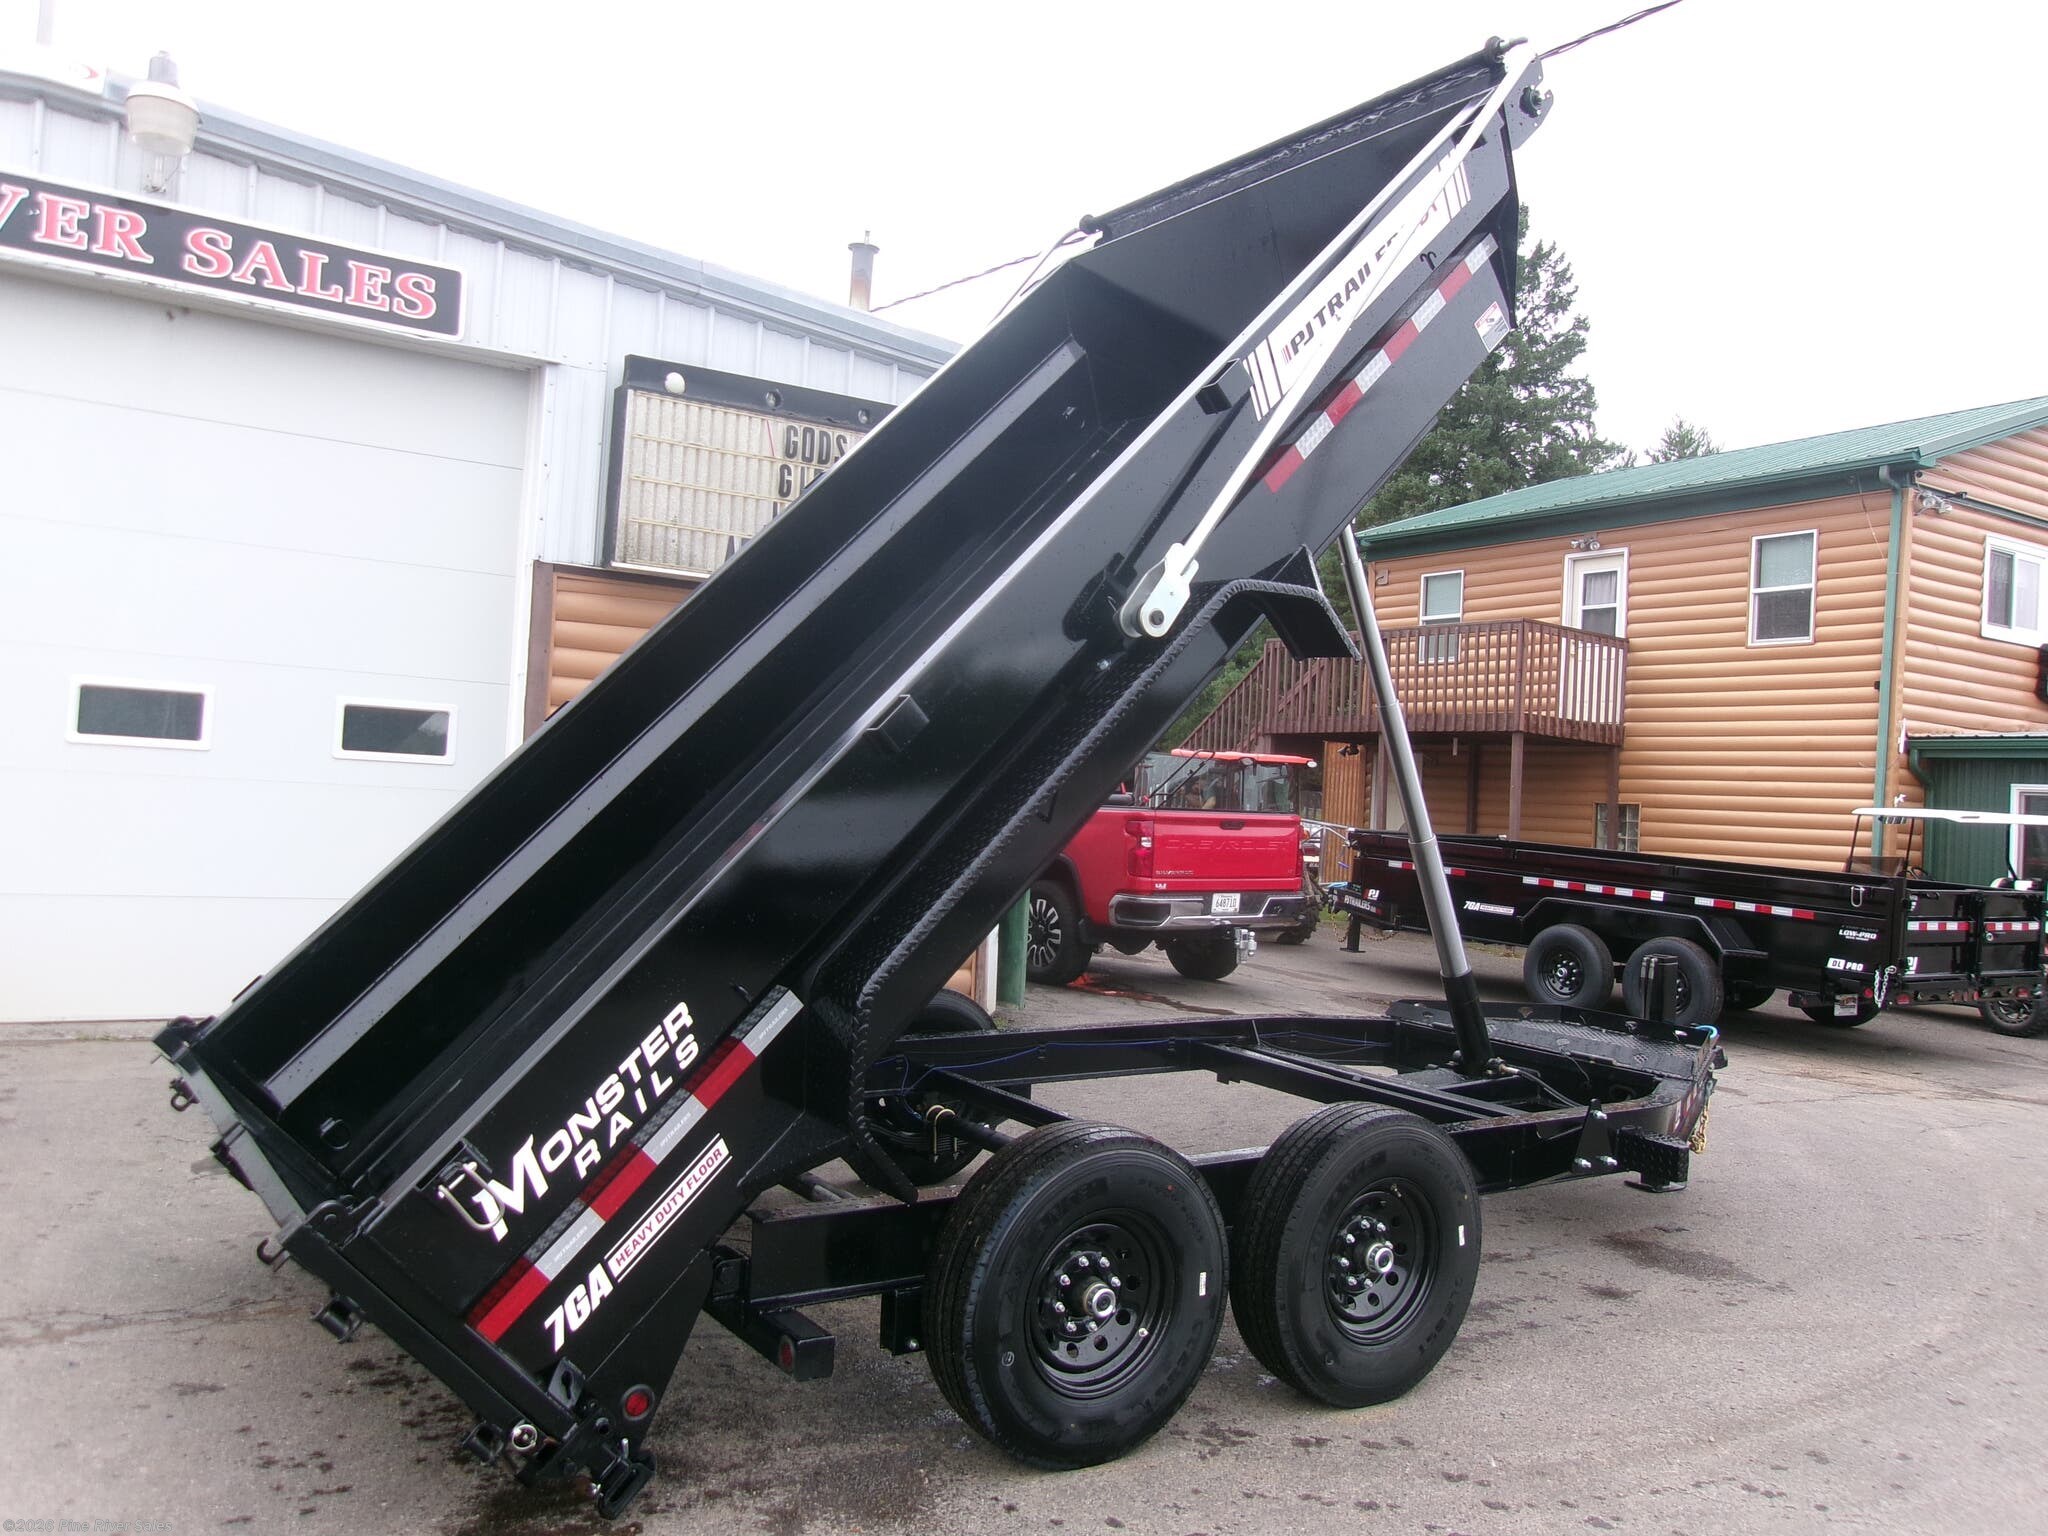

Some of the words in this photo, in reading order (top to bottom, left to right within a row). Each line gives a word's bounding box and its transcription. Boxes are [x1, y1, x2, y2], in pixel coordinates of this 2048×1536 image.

[183, 230, 437, 320] SALES
[1289, 231, 1399, 357] PJTRAIL
[1368, 889, 1380, 898] PJ
[1846, 962, 1864, 972] PRO
[472, 1001, 694, 1242] MONSTER
[573, 1033, 700, 1180] RAILS
[543, 1263, 614, 1353] 7GA
[614, 1222, 655, 1267] HEAVY
[654, 1187, 686, 1225] DUTY
[685, 1147, 723, 1191] FLOOR
